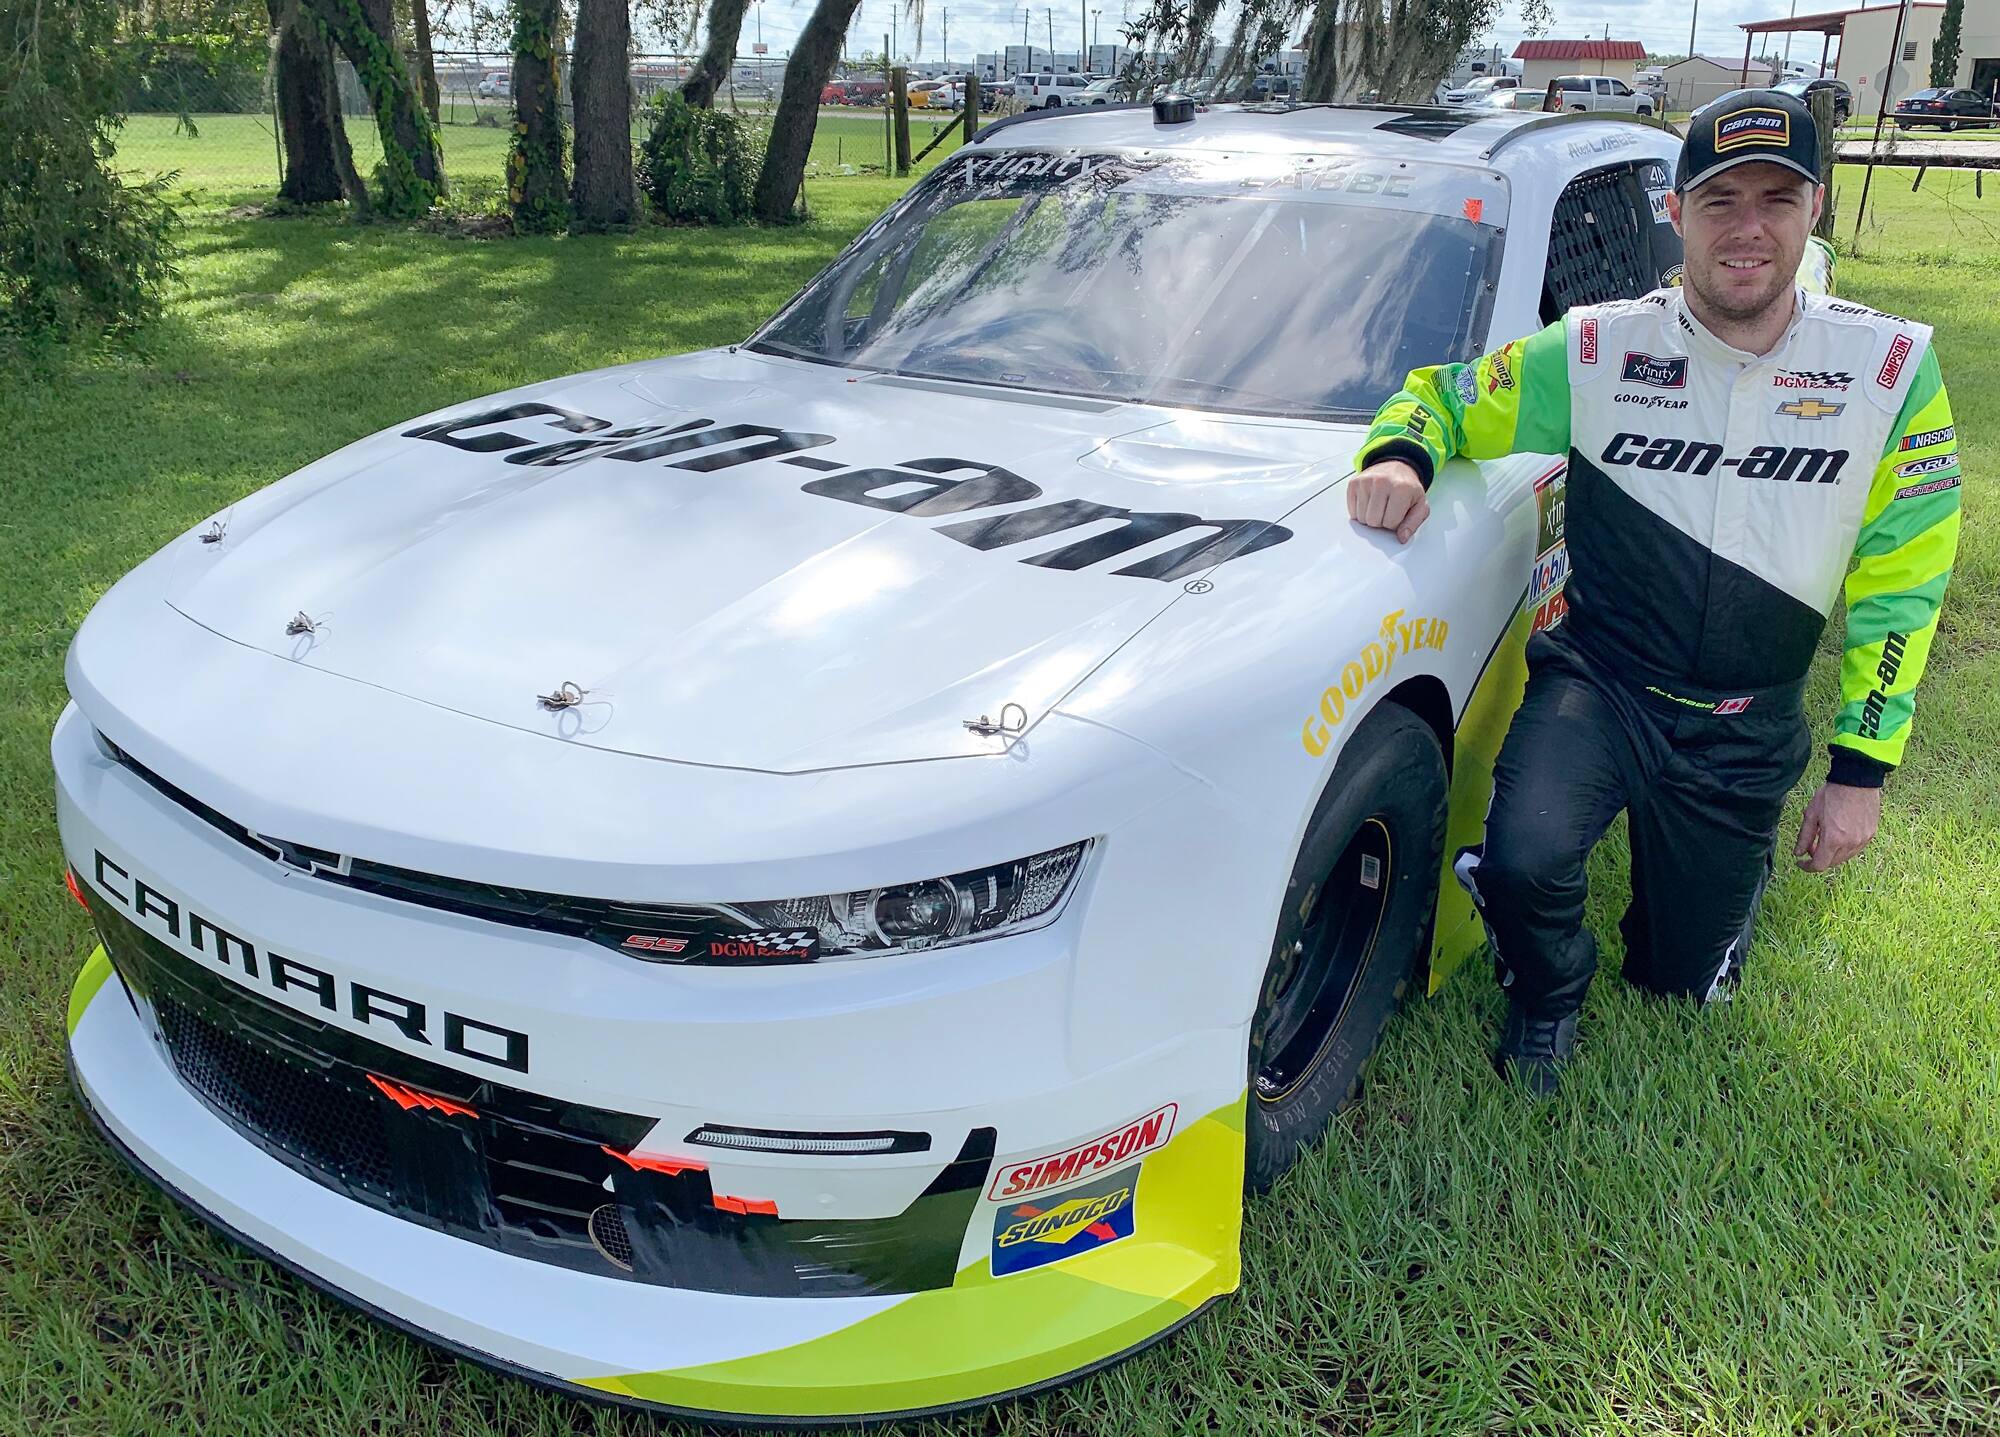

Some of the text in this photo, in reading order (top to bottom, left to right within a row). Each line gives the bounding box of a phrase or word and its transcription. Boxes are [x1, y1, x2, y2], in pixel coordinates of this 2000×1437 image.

[1721, 117, 1782, 133] can-am
[963, 151, 1112, 186] xfinity
[1651, 194, 1669, 213] WI
[1583, 321, 1595, 360] SIMPSON
[1633, 363, 1677, 382] xfinity
[1881, 339, 1909, 385] SIMPSON
[1773, 375, 1849, 392] DGM Racing
[1601, 432, 1850, 484] can-am
[402, 402, 1293, 583] can-am
[1546, 497, 1565, 535] xfin
[1529, 547, 1566, 602] Mobil
[1858, 631, 1907, 740] can-am
[95, 848, 528, 1074] CAMARO
[620, 934, 689, 953] SS
[709, 942, 809, 959] DGM Racing
[1002, 1113, 1164, 1196] SIMPSON
[1005, 1190, 1128, 1244] SUNOCO
